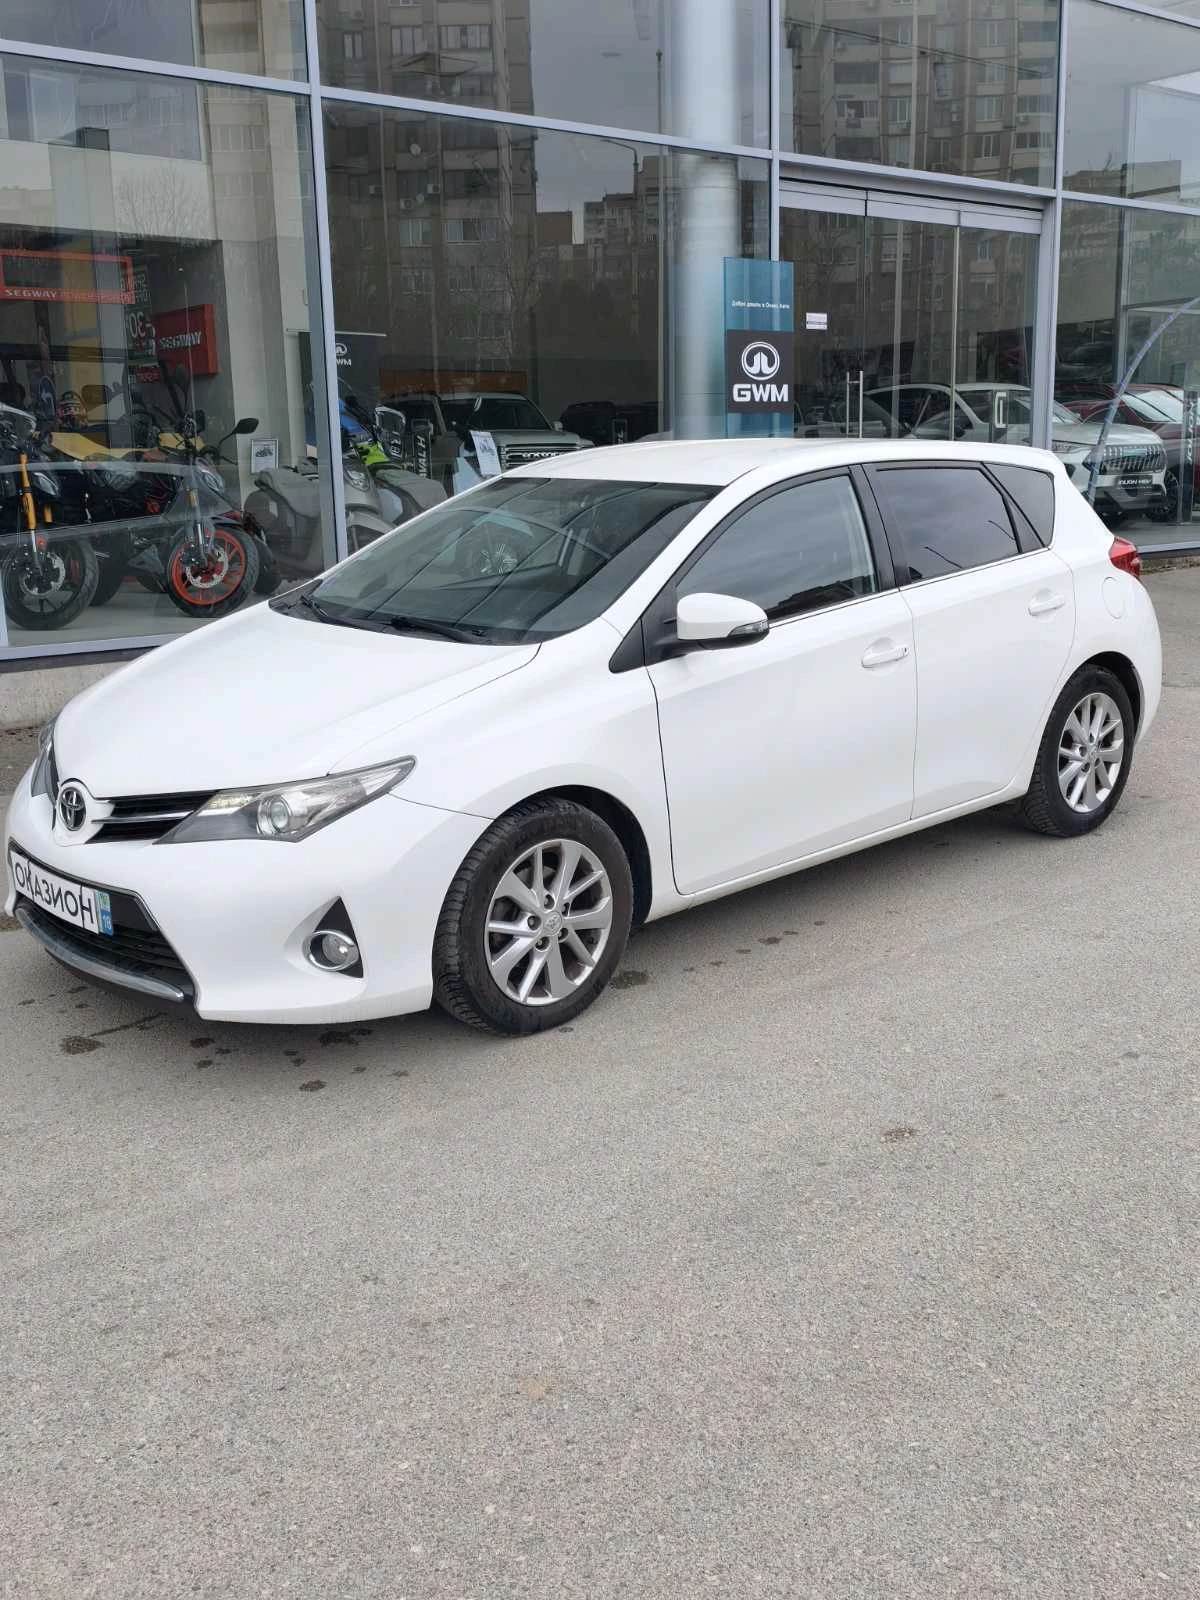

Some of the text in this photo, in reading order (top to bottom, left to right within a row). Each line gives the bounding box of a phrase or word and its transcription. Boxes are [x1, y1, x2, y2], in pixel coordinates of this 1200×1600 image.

[4, 289, 58, 298] SEGWAY
[159, 330, 203, 349] SEGWAY
[336, 358, 352, 366] WM
[732, 383, 789, 402] GWM
[15, 862, 94, 925] ОКАЗИОН
